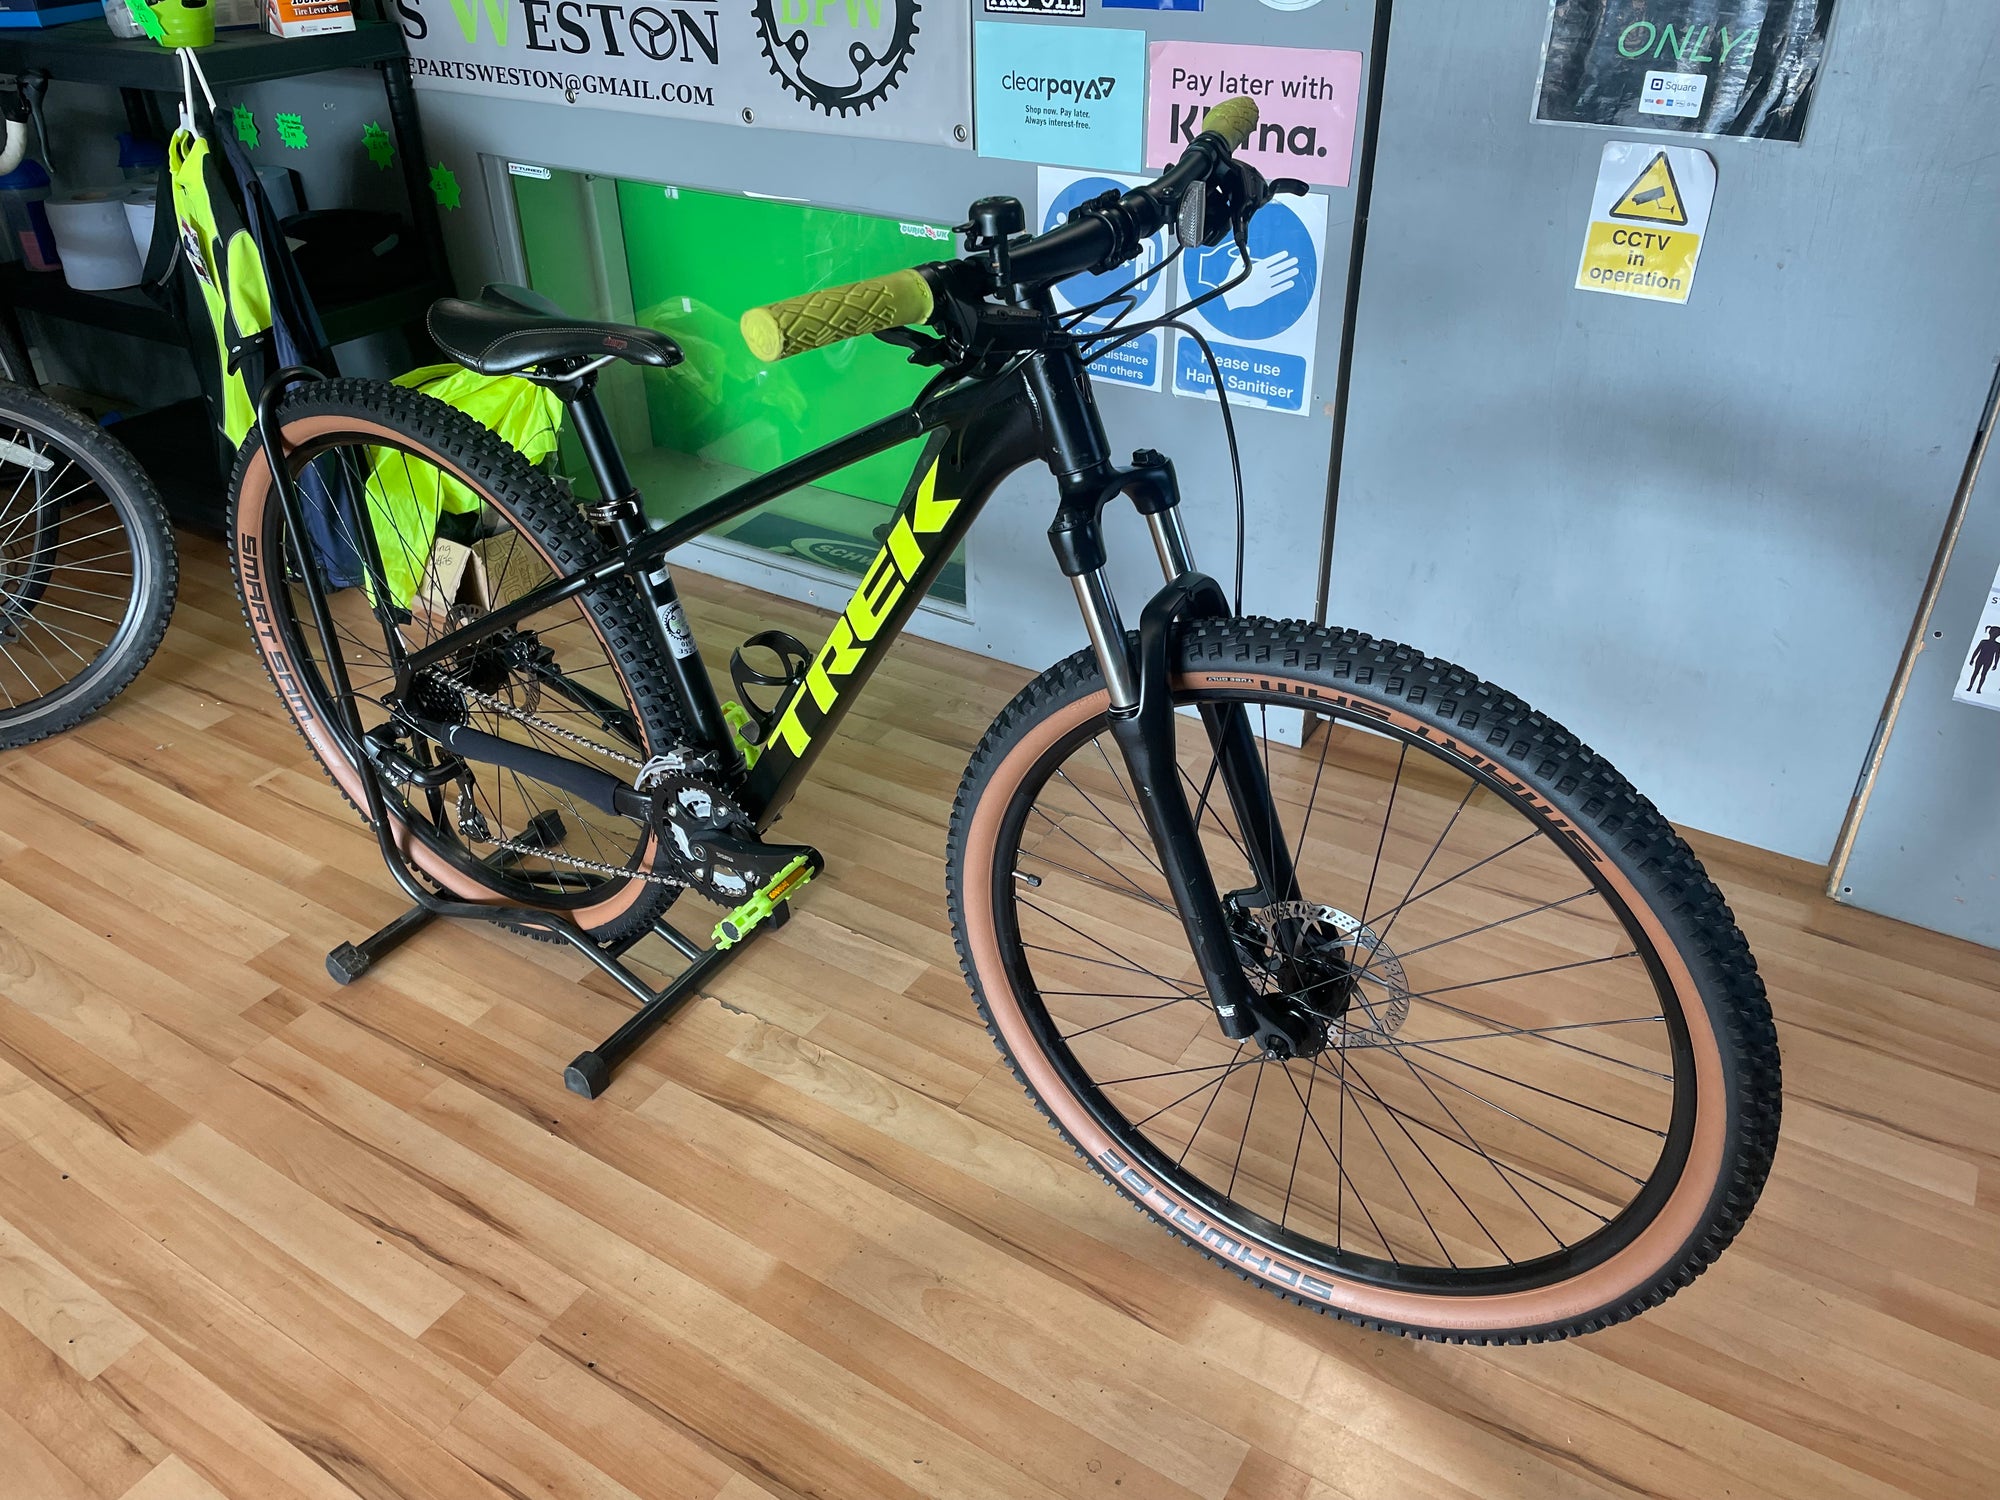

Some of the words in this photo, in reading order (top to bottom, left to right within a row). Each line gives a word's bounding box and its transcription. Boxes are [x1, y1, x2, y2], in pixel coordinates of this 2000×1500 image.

[293, 8, 308, 16] Tire
[308, 6, 327, 15] Lever
[328, 4, 339, 12] Set
[1001, 69, 1085, 103] clearpay
[1172, 67, 1213, 97] Pay
[1219, 70, 1274, 96] later
[1281, 75, 1334, 100] with
[1665, 81, 1698, 93] Square
[1025, 104, 1042, 115] Shop
[1043, 107, 1058, 115] now.
[1060, 107, 1072, 117] Pay
[1073, 108, 1091, 118] later.
[1025, 115, 1047, 126] Always
[1048, 117, 1091, 129] interest-free.
[1170, 103, 1327, 158] Kna.
[1612, 230, 1671, 251] CCTV
[1627, 250, 1645, 266] in
[1589, 267, 1681, 291] operation
[1086, 362, 1107, 373] rom
[1110, 365, 1143, 380] others
[1201, 351, 1249, 371] Pease
[1254, 363, 1280, 377] use
[1186, 367, 1224, 385] Han
[1228, 375, 1294, 399] Sanitiser
[767, 454, 960, 758] TREK
[242, 533, 277, 643] SMART
[269, 651, 313, 721] SAM
[1097, 1148, 1334, 1300] SCHWALBE
